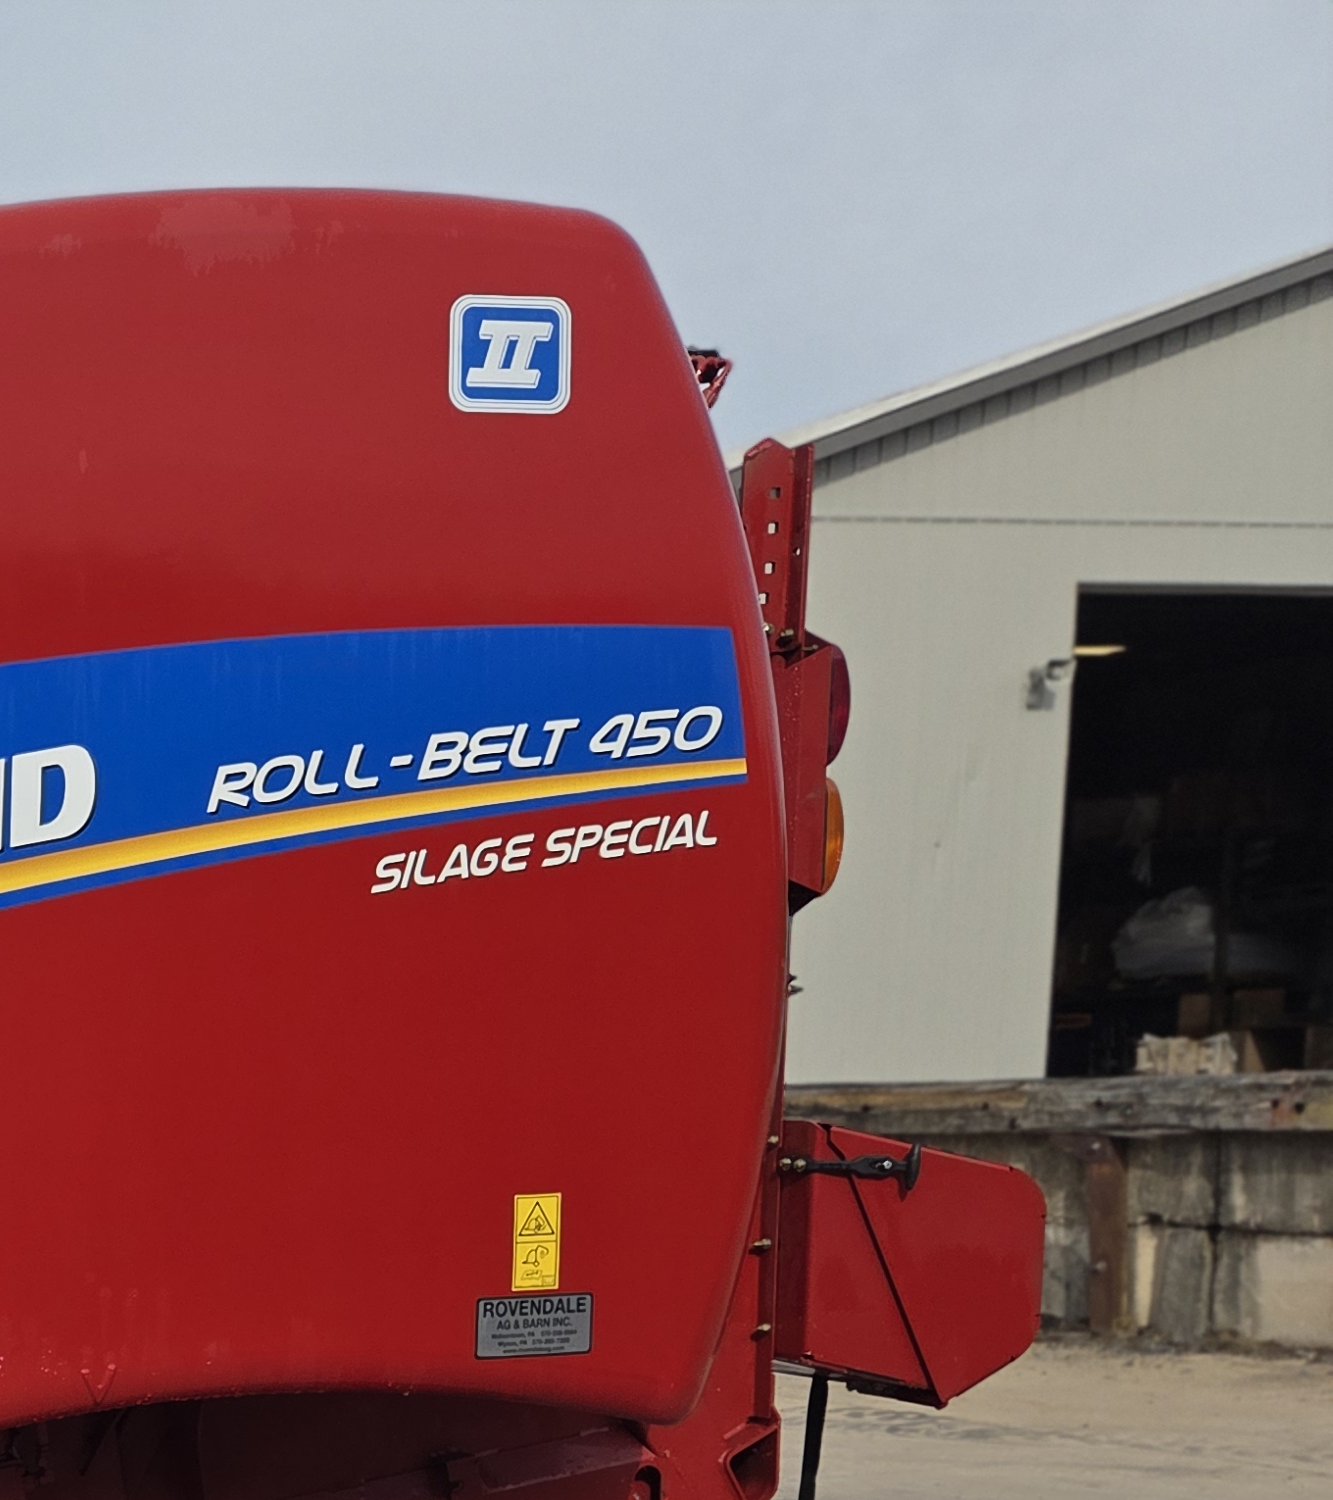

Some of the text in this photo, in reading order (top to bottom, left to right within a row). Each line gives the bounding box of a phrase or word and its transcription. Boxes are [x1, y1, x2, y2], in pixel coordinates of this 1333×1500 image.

[465, 319, 554, 389] II
[206, 705, 723, 814] ROLL-BELT 450
[370, 810, 718, 894] SILAGE SPECIAL
[482, 1296, 587, 1319] ROVENDALE
[523, 1317, 551, 1329] BARN
[552, 1315, 572, 1327] INC.
